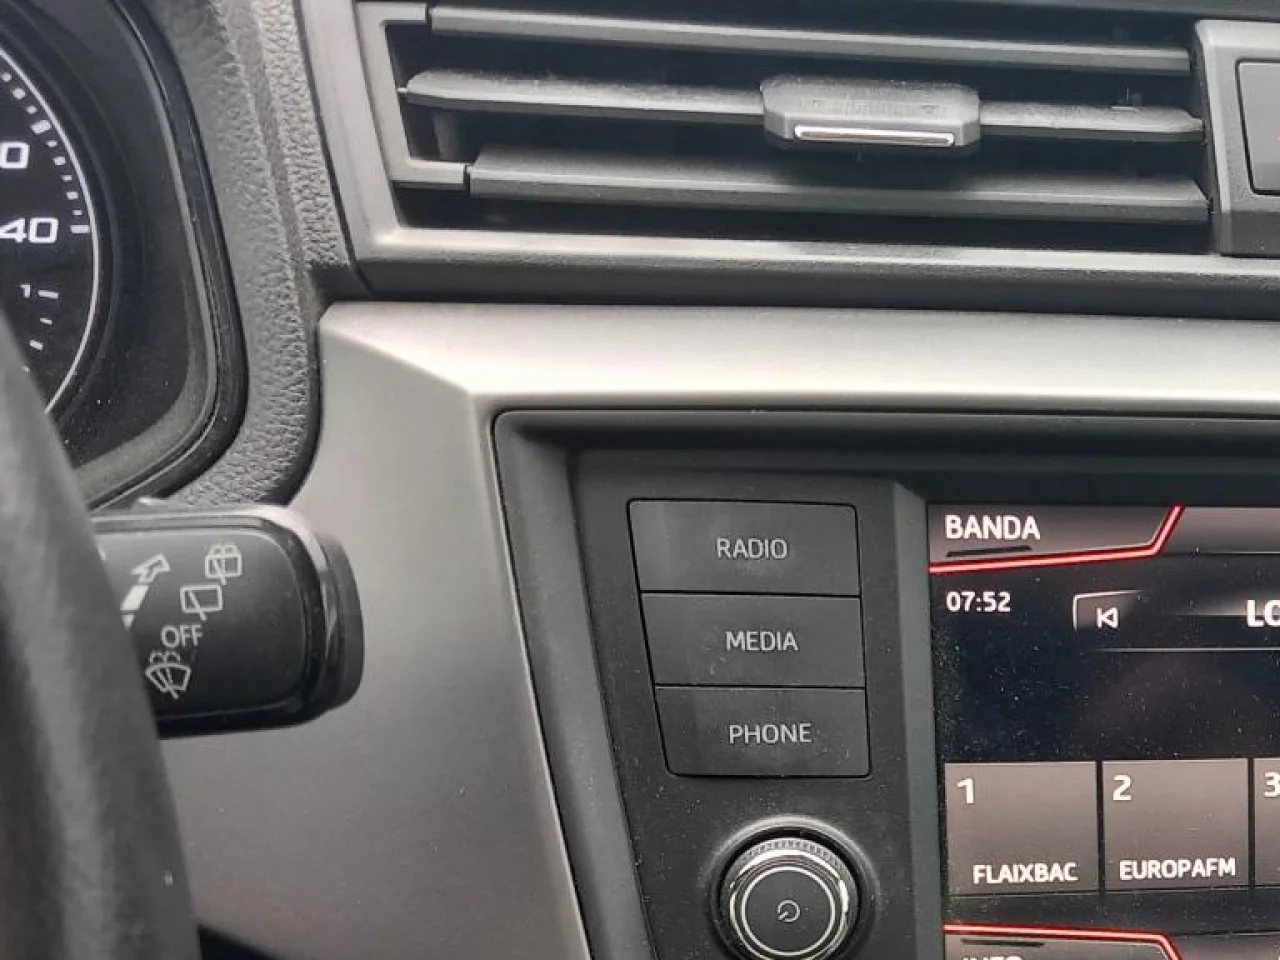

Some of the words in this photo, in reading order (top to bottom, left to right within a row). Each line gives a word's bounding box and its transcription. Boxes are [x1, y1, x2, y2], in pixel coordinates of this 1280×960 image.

[945, 514, 1041, 541] BANDA
[716, 537, 788, 559] RADIO
[946, 590, 1011, 613] 07:52
[160, 624, 203, 648] OFF
[726, 630, 799, 651] MEDIA
[729, 722, 811, 744] PHONE
[957, 777, 974, 804] 1
[1112, 774, 1131, 801] 2
[972, 862, 1078, 884] FLAIXBAC
[1119, 857, 1236, 881] EUROPAFM
